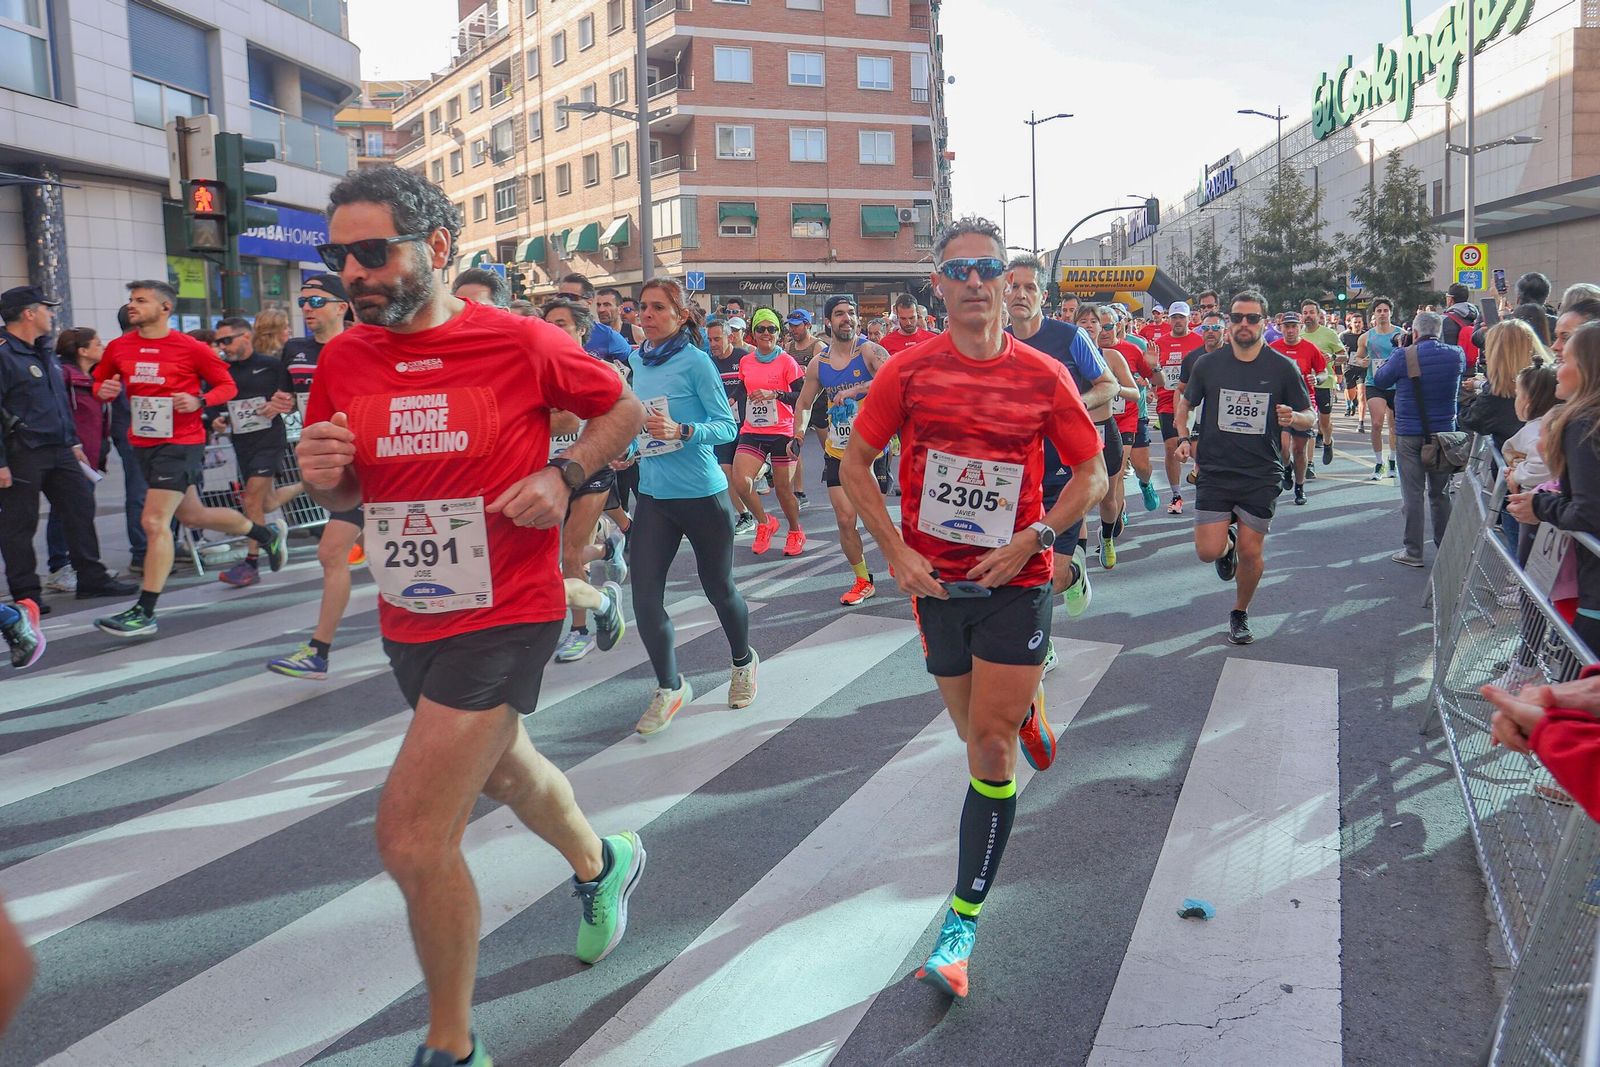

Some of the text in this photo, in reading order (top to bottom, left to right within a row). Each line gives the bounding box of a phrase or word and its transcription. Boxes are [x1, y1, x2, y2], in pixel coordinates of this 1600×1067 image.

[1311, 72, 1336, 140] El
[1333, 43, 1397, 126] Corte
[1464, 252, 1478, 260] 30
[1067, 270, 1145, 282] MARCELINO
[389, 394, 448, 411] MEMORIAL
[138, 410, 157, 421] 197
[752, 406, 768, 415] 229
[1226, 404, 1259, 417] 2858
[389, 408, 449, 434] PADRE
[376, 431, 469, 457] MARCELINO
[936, 482, 1000, 512] 2305
[954, 509, 976, 517] JAVIER
[384, 537, 458, 568] 2391
